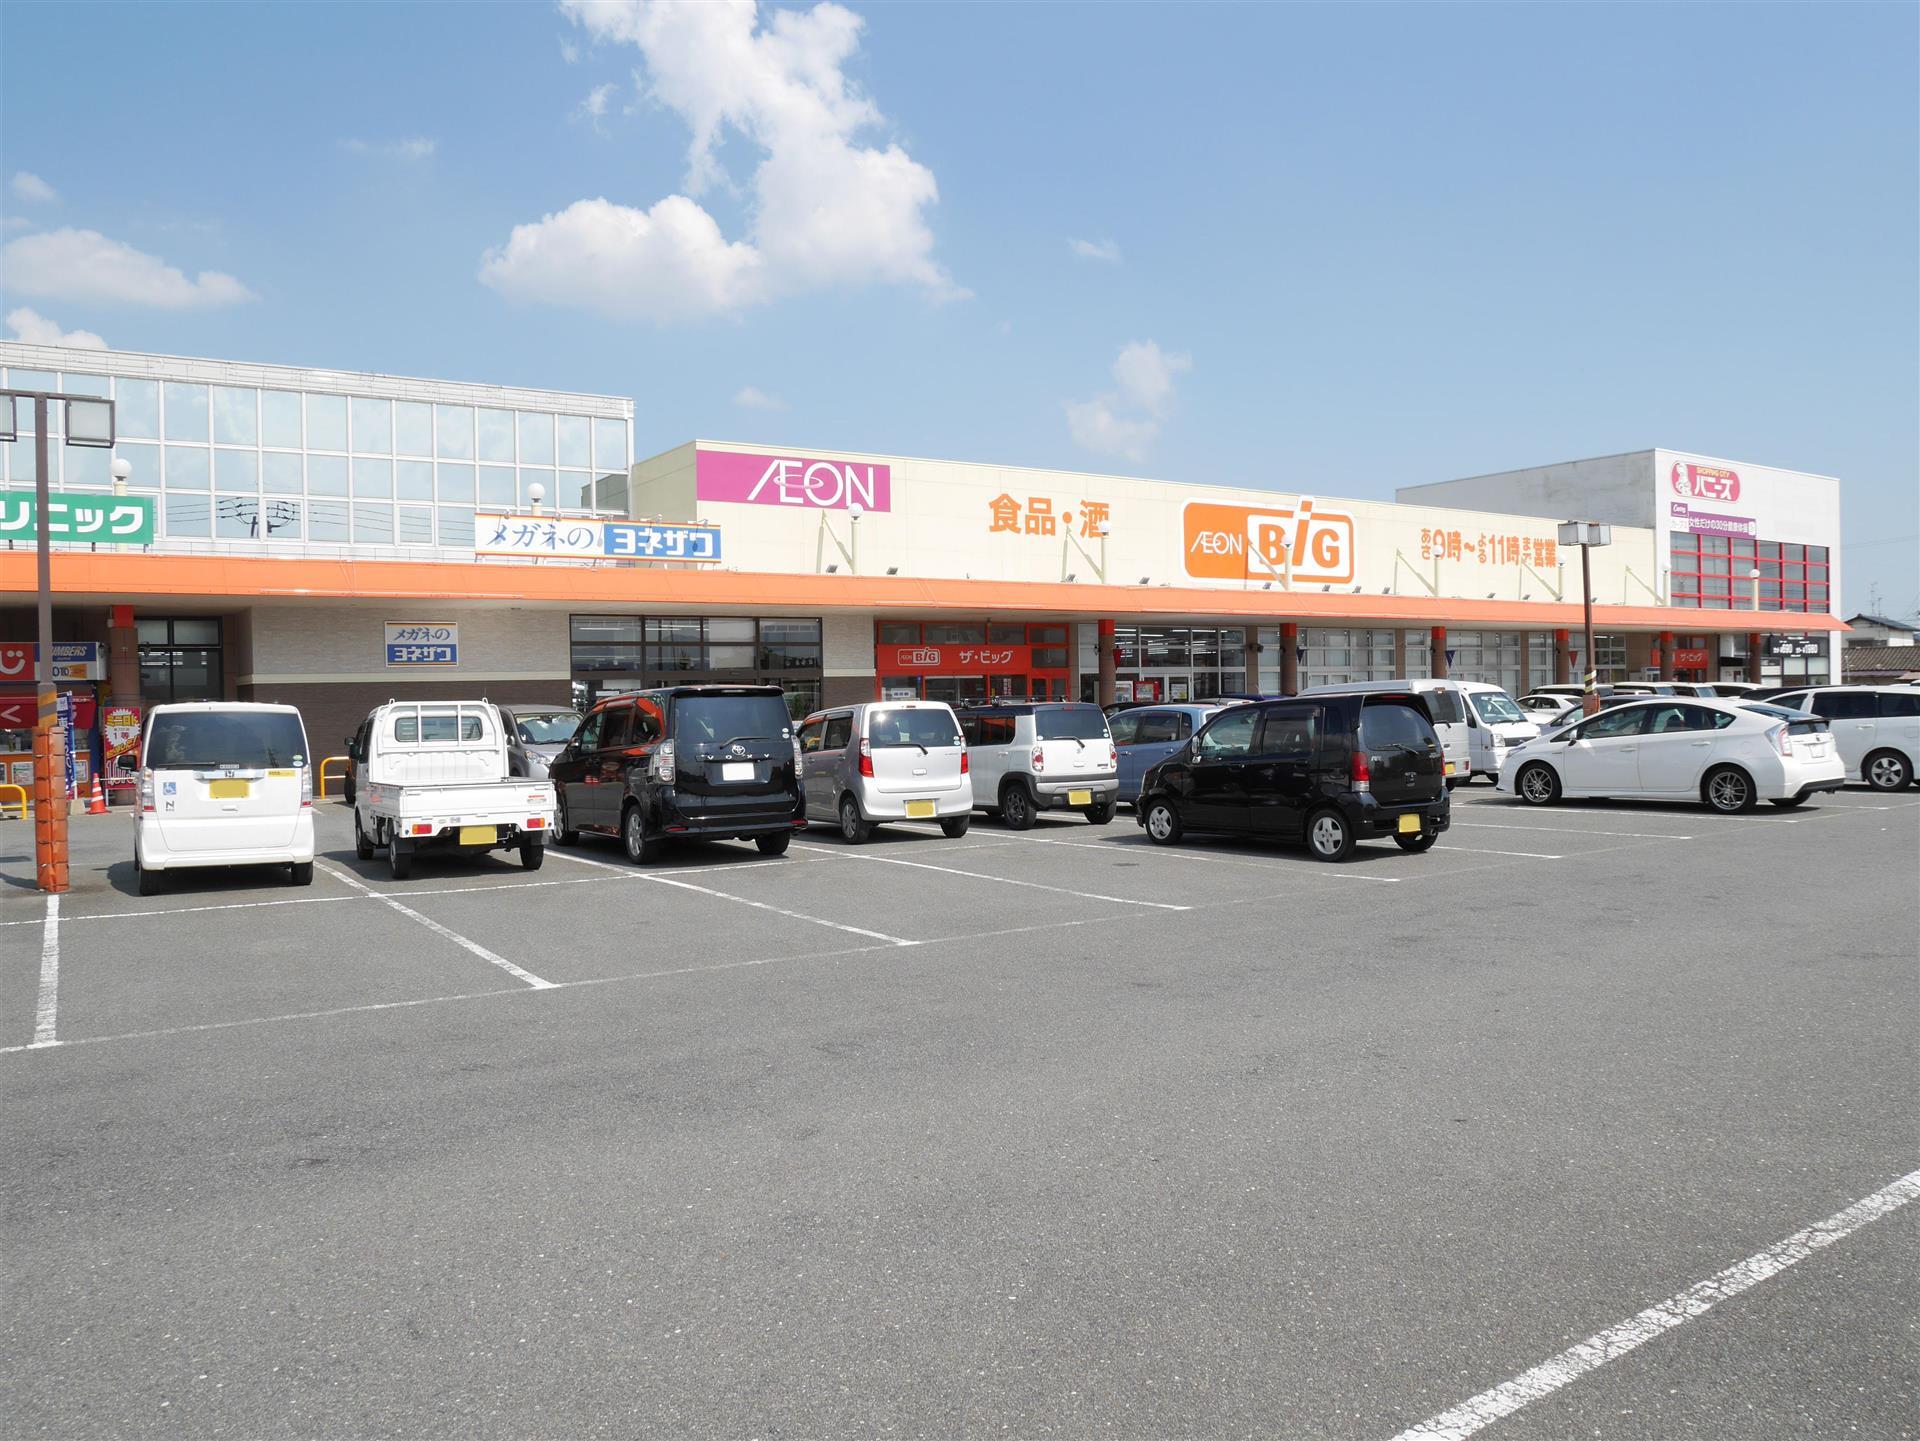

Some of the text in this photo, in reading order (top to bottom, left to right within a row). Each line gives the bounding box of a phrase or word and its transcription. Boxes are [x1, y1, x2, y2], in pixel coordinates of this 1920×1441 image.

[487, 522, 713, 556] メガネの ヨネザワ
[394, 627, 451, 642] メガネの
[394, 646, 451, 662] ヨネザワ
[959, 650, 1013, 664] ザ・ビッグ
